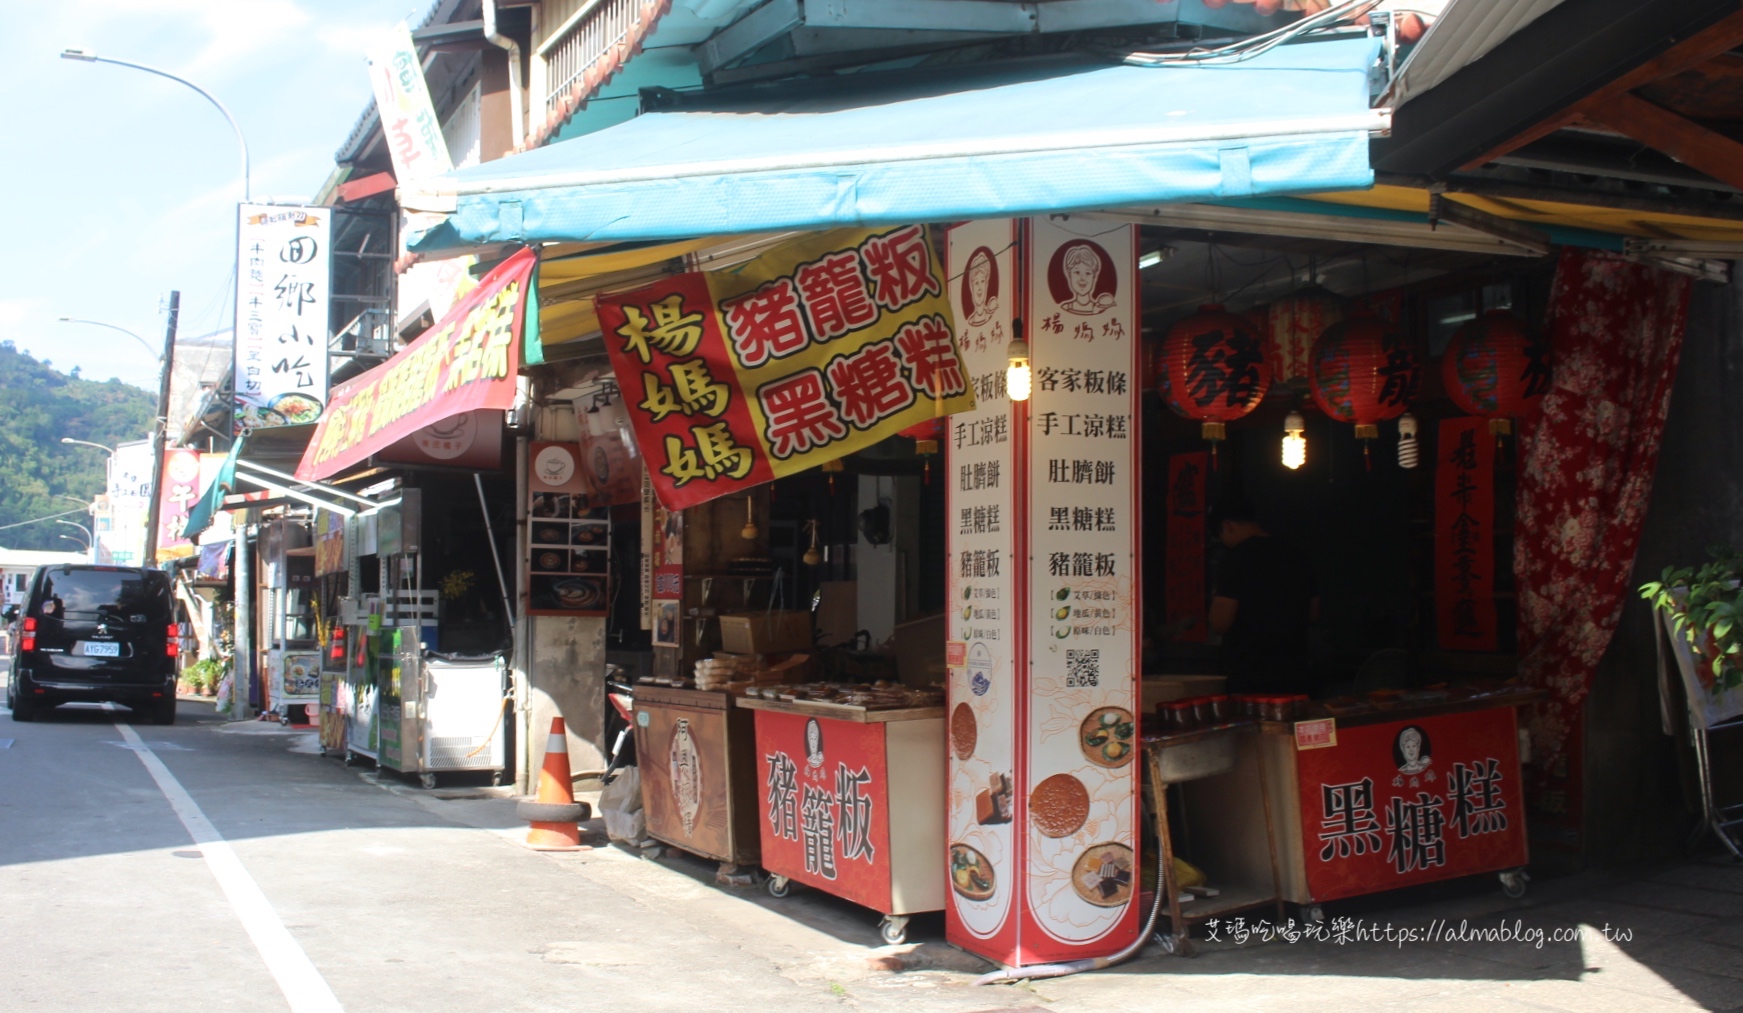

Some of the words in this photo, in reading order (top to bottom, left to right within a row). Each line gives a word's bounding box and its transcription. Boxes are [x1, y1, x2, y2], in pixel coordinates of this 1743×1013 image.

[272, 236, 318, 388] 回鄉小吃
[722, 225, 940, 366] 豬籠粄
[1037, 367, 1126, 395] 客家粄條
[1187, 327, 1264, 409] 豬
[616, 294, 753, 487] 楊媽媽
[759, 316, 965, 457] 黑糖糕
[954, 414, 1007, 450] 手工涼糕
[1037, 412, 1126, 438] 手工涼糕
[960, 460, 1000, 491] 肚臍餅
[1049, 459, 1115, 485] 肚臍餅
[960, 504, 1000, 535] 黑糖糕
[1048, 507, 1115, 531] 黑糖糕
[960, 549, 1000, 578] 豬籠粄
[1049, 552, 1115, 577] 豬籠粄
[766, 751, 874, 880] 豬籠粄
[1318, 757, 1508, 873] 黑糖糕
